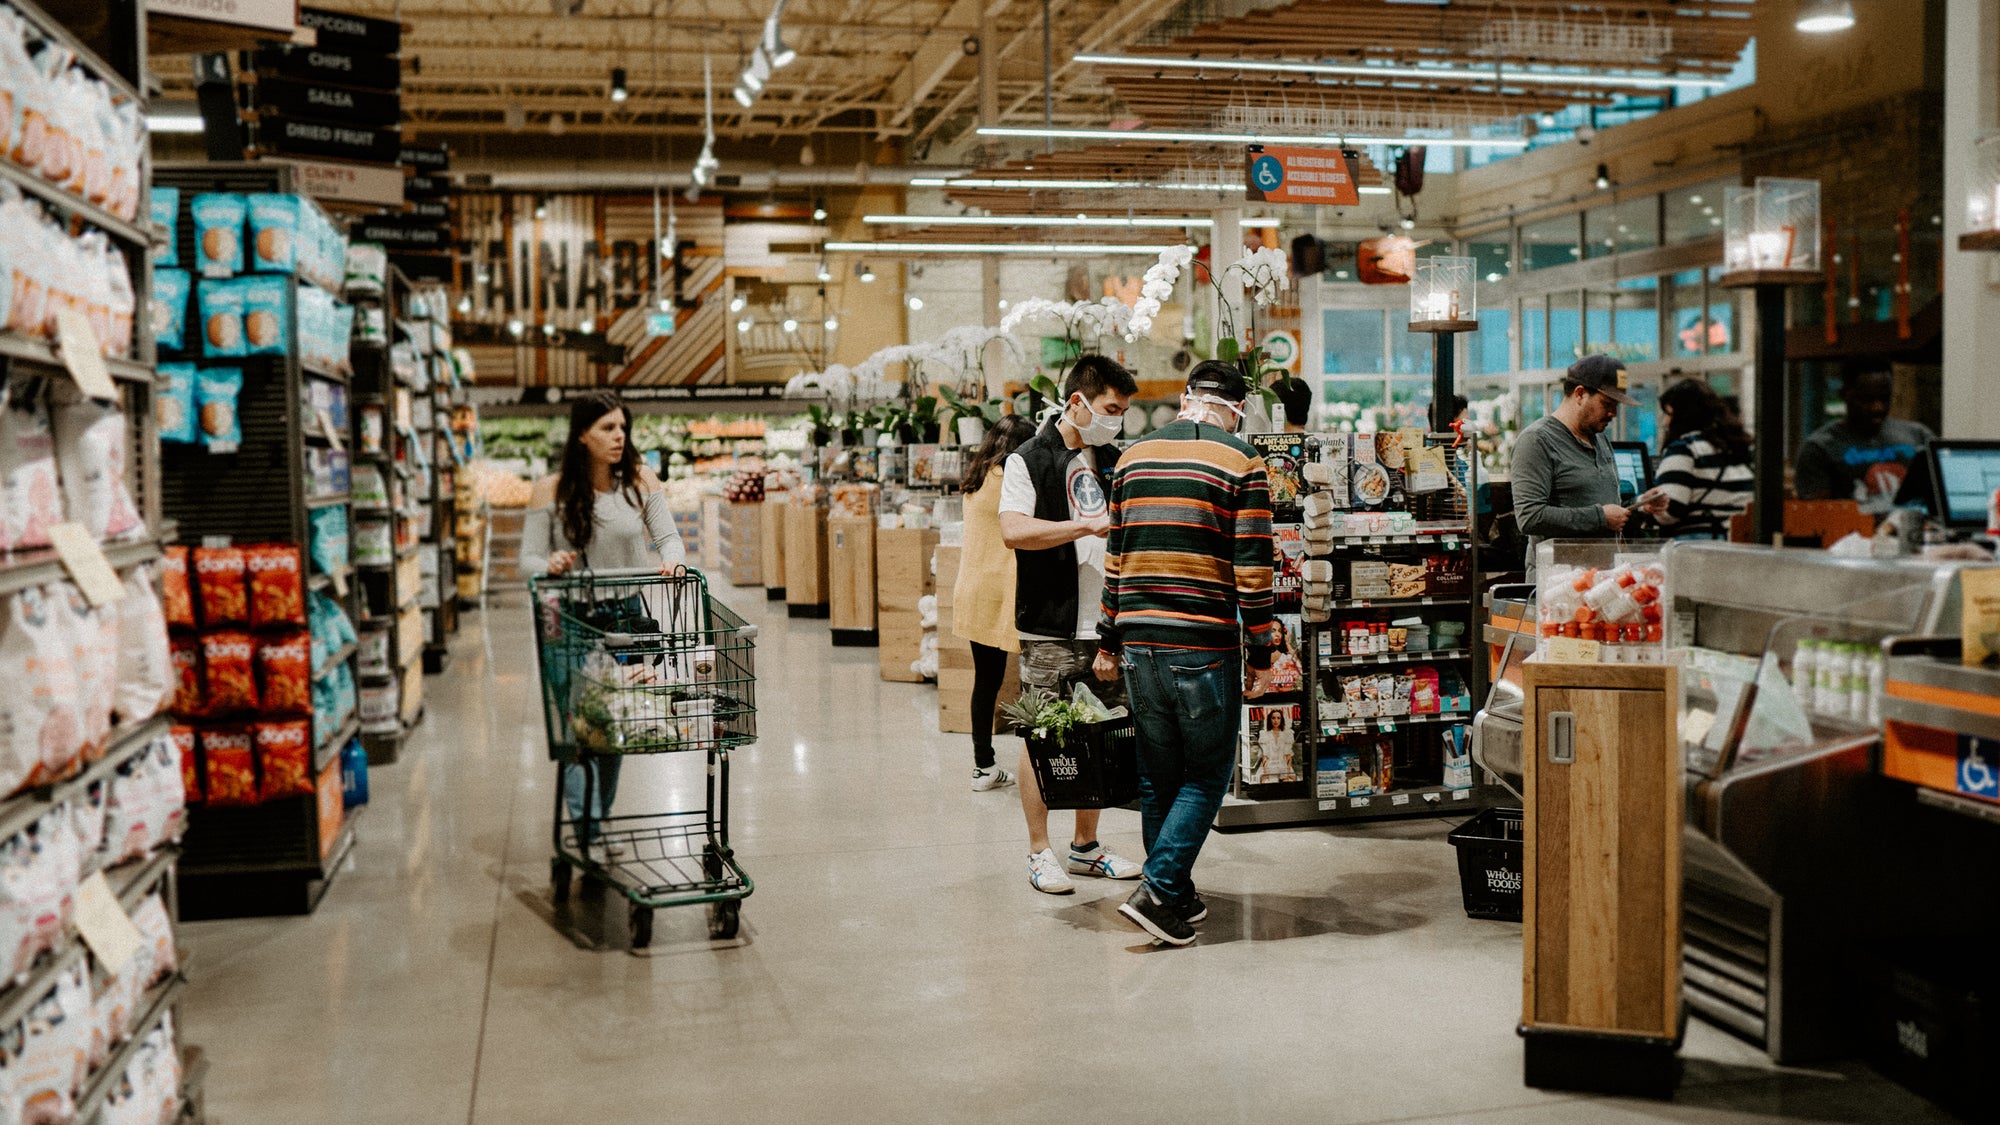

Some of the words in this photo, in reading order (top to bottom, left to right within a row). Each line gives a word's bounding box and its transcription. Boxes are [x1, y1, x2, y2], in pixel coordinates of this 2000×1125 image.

[301, 13, 367, 36] OPCORN
[213, 55, 227, 78] 4
[307, 51, 352, 72] CHIPS
[307, 88, 354, 108] SALSA
[286, 122, 333, 142] DRIED
[333, 128, 376, 147] FRUIT
[1781, 225, 1796, 270] 7
[1254, 438, 1302, 446] PLANT-BASED
[248, 555, 296, 573] dang
[257, 728, 304, 746] dang
[1048, 757, 1077, 766] WHOLE
[1052, 766, 1079, 776] FOODS
[1485, 870, 1522, 881] WHOLE
[1487, 879, 1521, 890] FOODS
